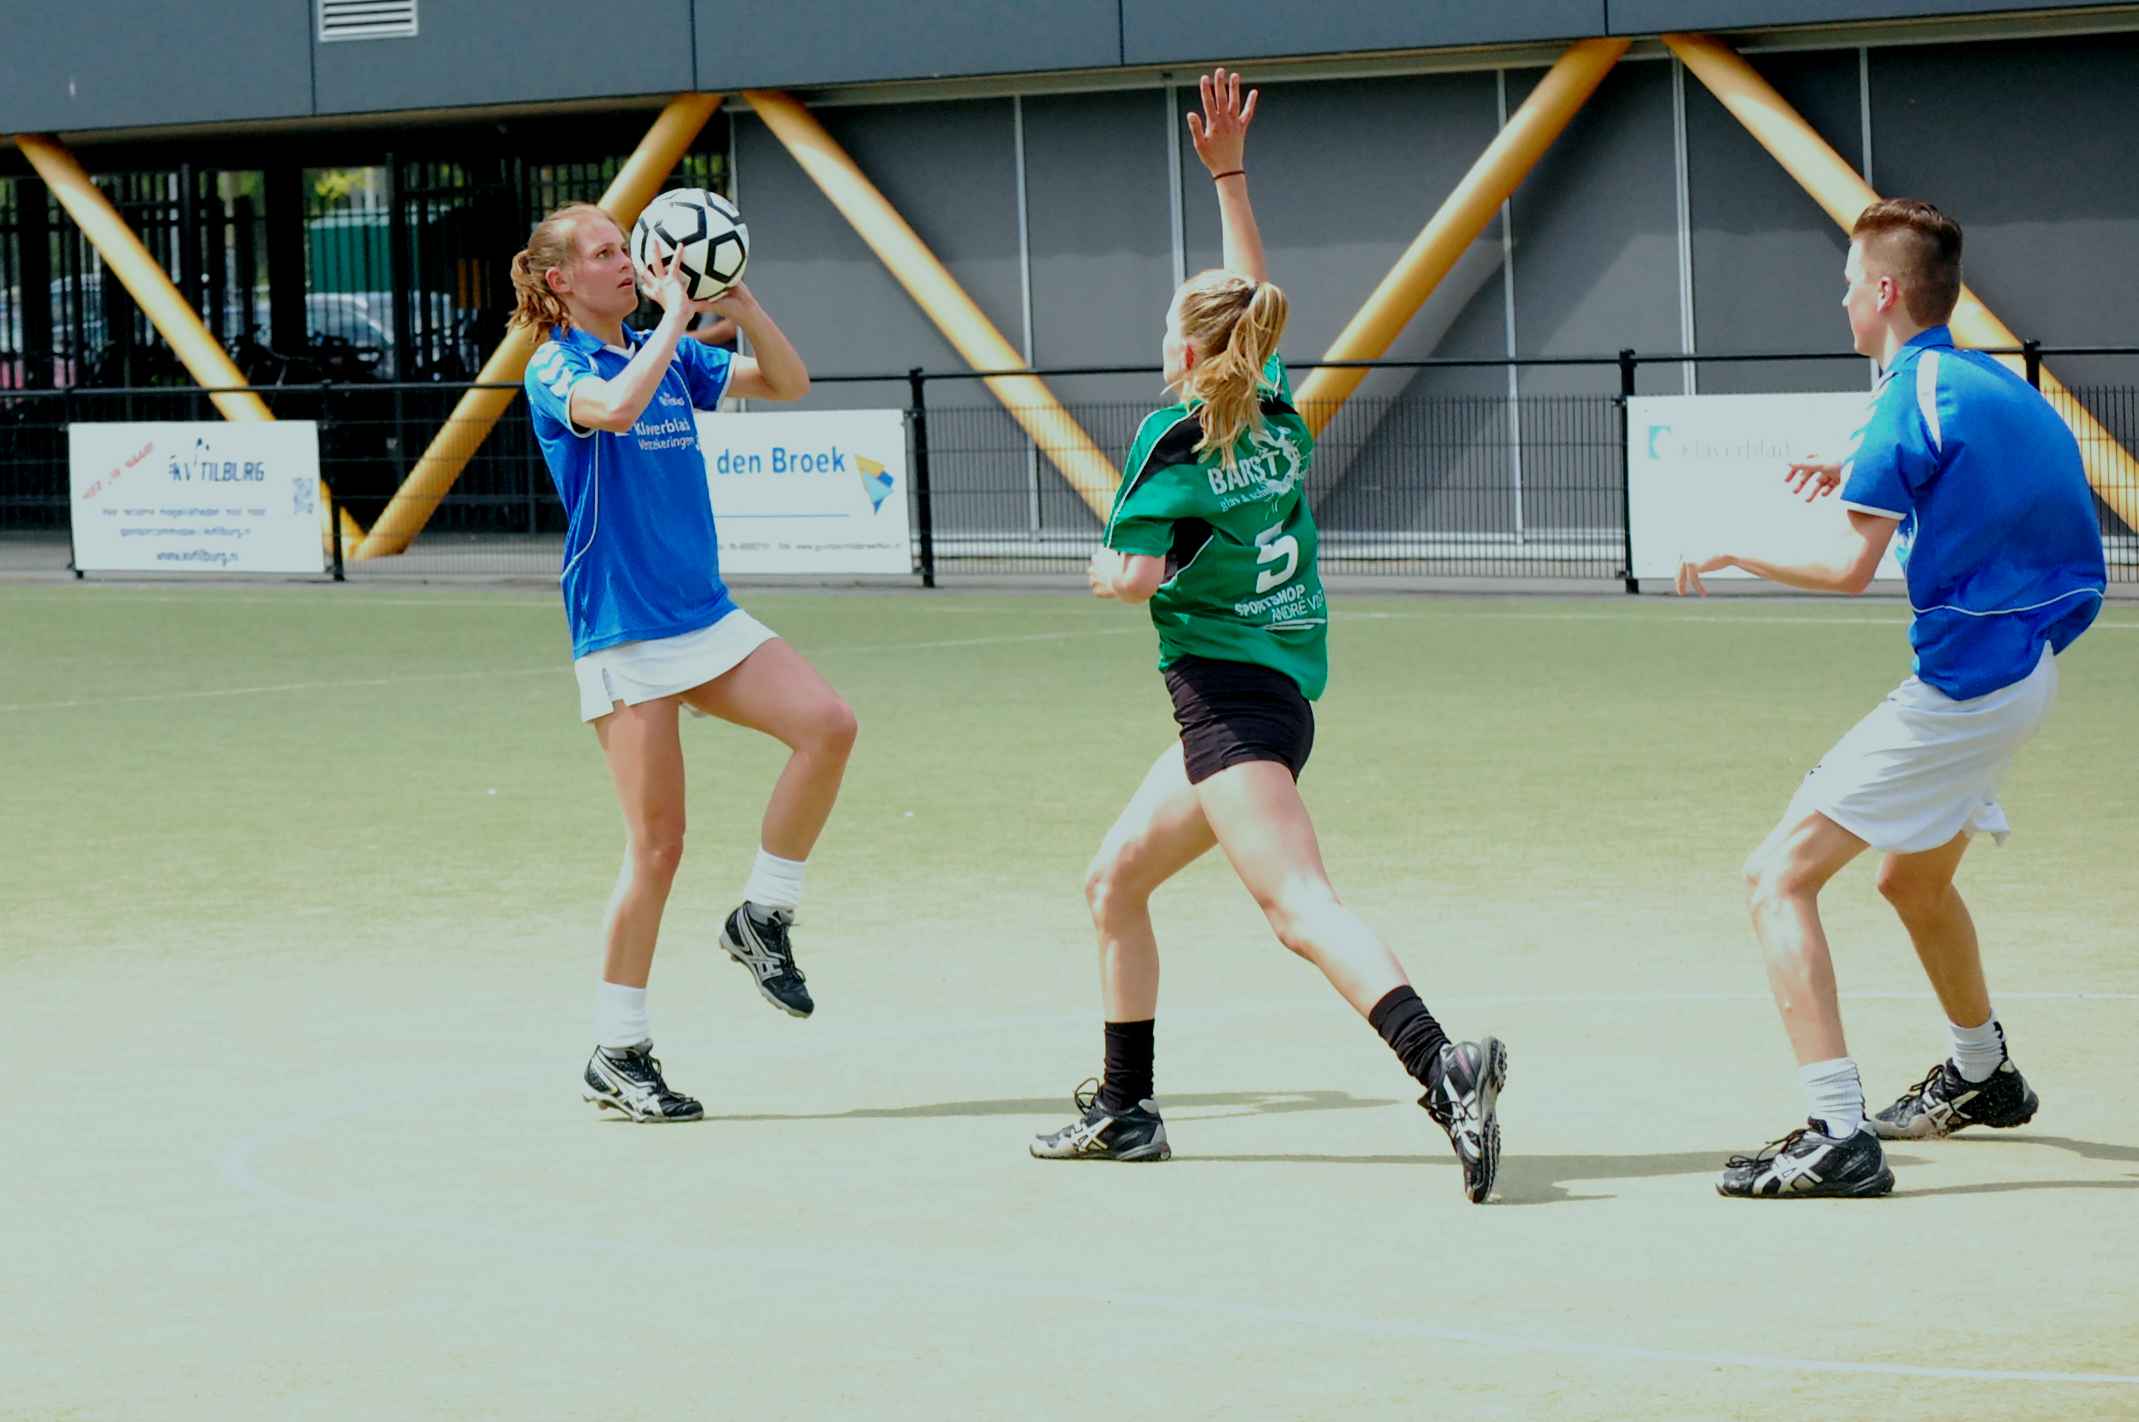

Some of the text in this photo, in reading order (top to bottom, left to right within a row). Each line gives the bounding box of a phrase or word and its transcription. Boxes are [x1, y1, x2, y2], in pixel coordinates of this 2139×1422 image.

[717, 446, 846, 474] den Broek
[1207, 450, 1280, 495] BARST
[1254, 519, 1299, 593] 5
